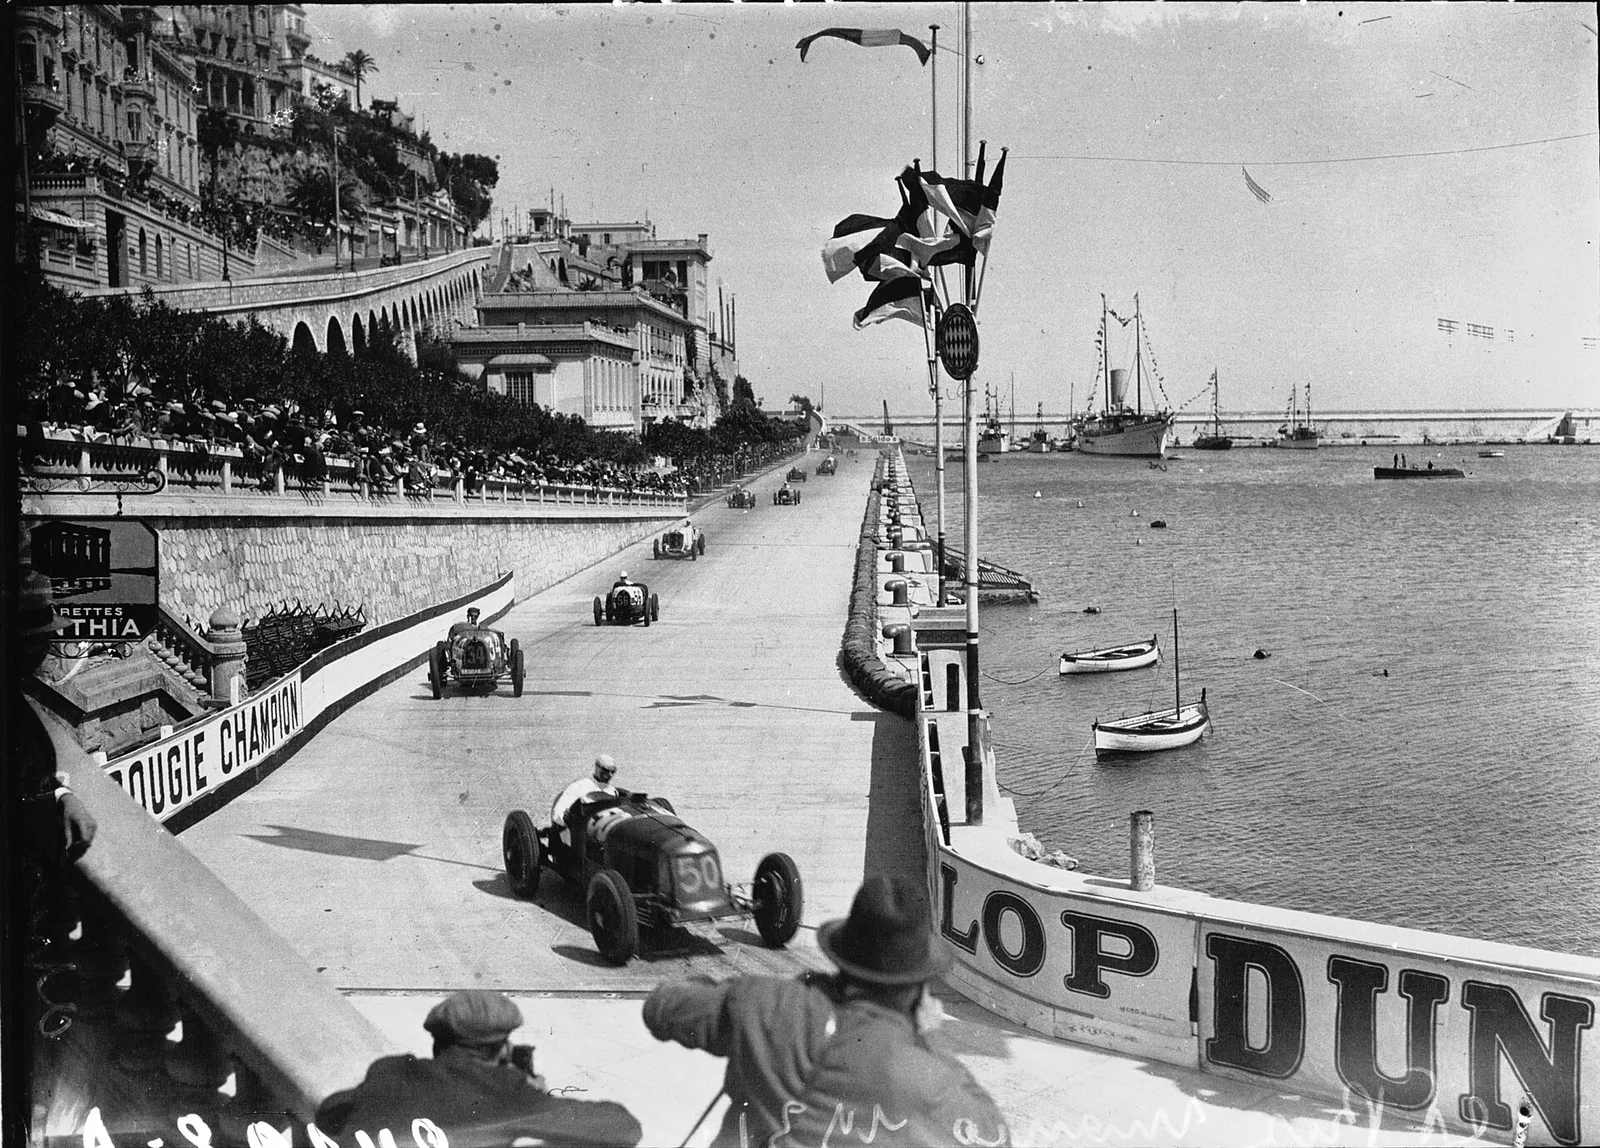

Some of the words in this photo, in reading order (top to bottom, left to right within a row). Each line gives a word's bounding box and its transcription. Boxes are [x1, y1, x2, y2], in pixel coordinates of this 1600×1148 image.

[107, 731, 208, 815] OUGIE
[219, 680, 299, 776] CHAMPION
[677, 856, 720, 894] 50
[940, 861, 1159, 998] LOP
[1205, 931, 1594, 1146] DUN
